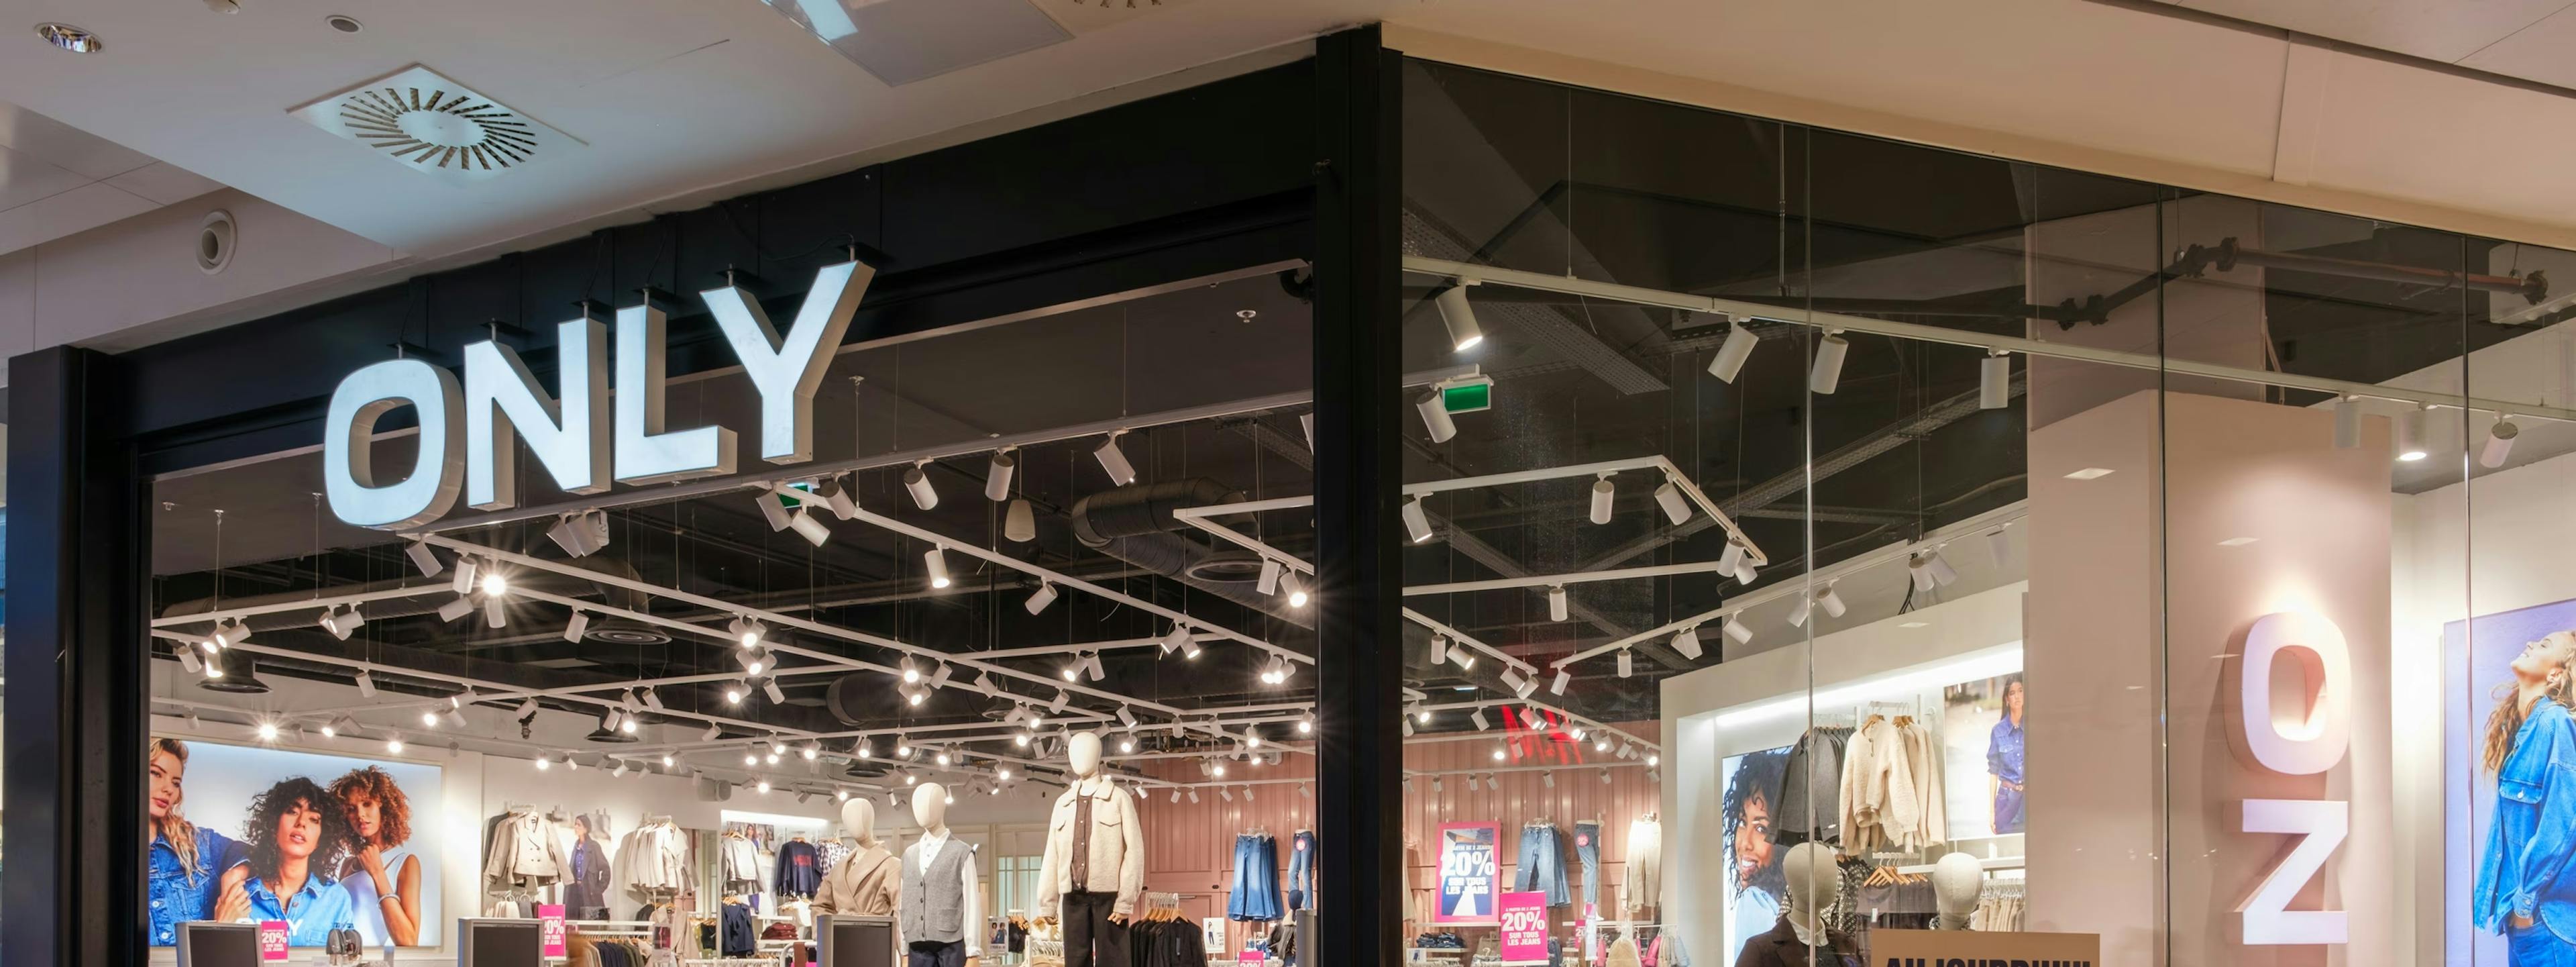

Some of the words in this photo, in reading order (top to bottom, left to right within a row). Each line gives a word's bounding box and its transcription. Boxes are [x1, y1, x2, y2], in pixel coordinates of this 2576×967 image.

[324, 260, 875, 531] ONLY
[1440, 850, 1496, 876] 20%
[1502, 911, 1546, 932] 20%
[262, 931, 287, 944] 20%
[1520, 937, 1542, 946] JEANS
[1522, 931, 1540, 939] TOUS
